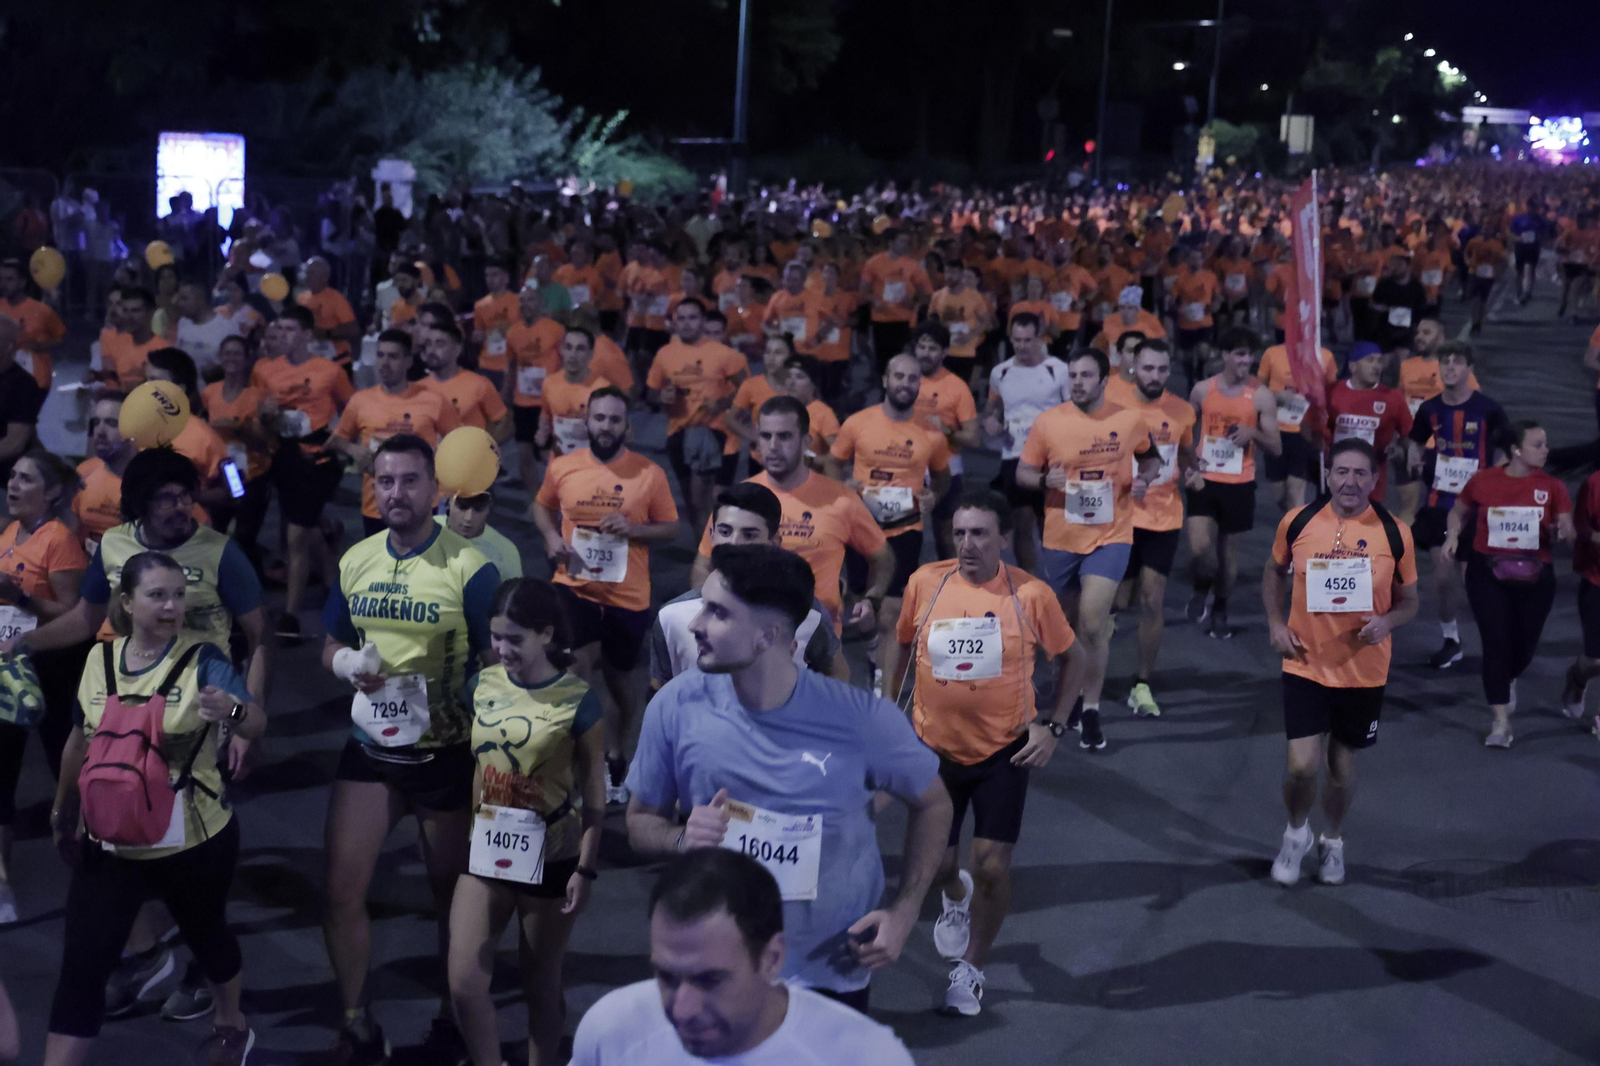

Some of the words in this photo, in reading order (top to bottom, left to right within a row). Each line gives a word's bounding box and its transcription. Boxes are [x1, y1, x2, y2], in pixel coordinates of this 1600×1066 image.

[1500, 521, 1529, 532] 18244
[586, 547, 613, 562] 3733
[368, 581, 409, 595] RUNNERS
[1324, 577, 1356, 590] 4526
[350, 595, 441, 625] BARREÑOS
[948, 639, 983, 654] 3732
[371, 699, 408, 719] 7294
[485, 829, 530, 852] 14075
[739, 833, 799, 866] 16044
